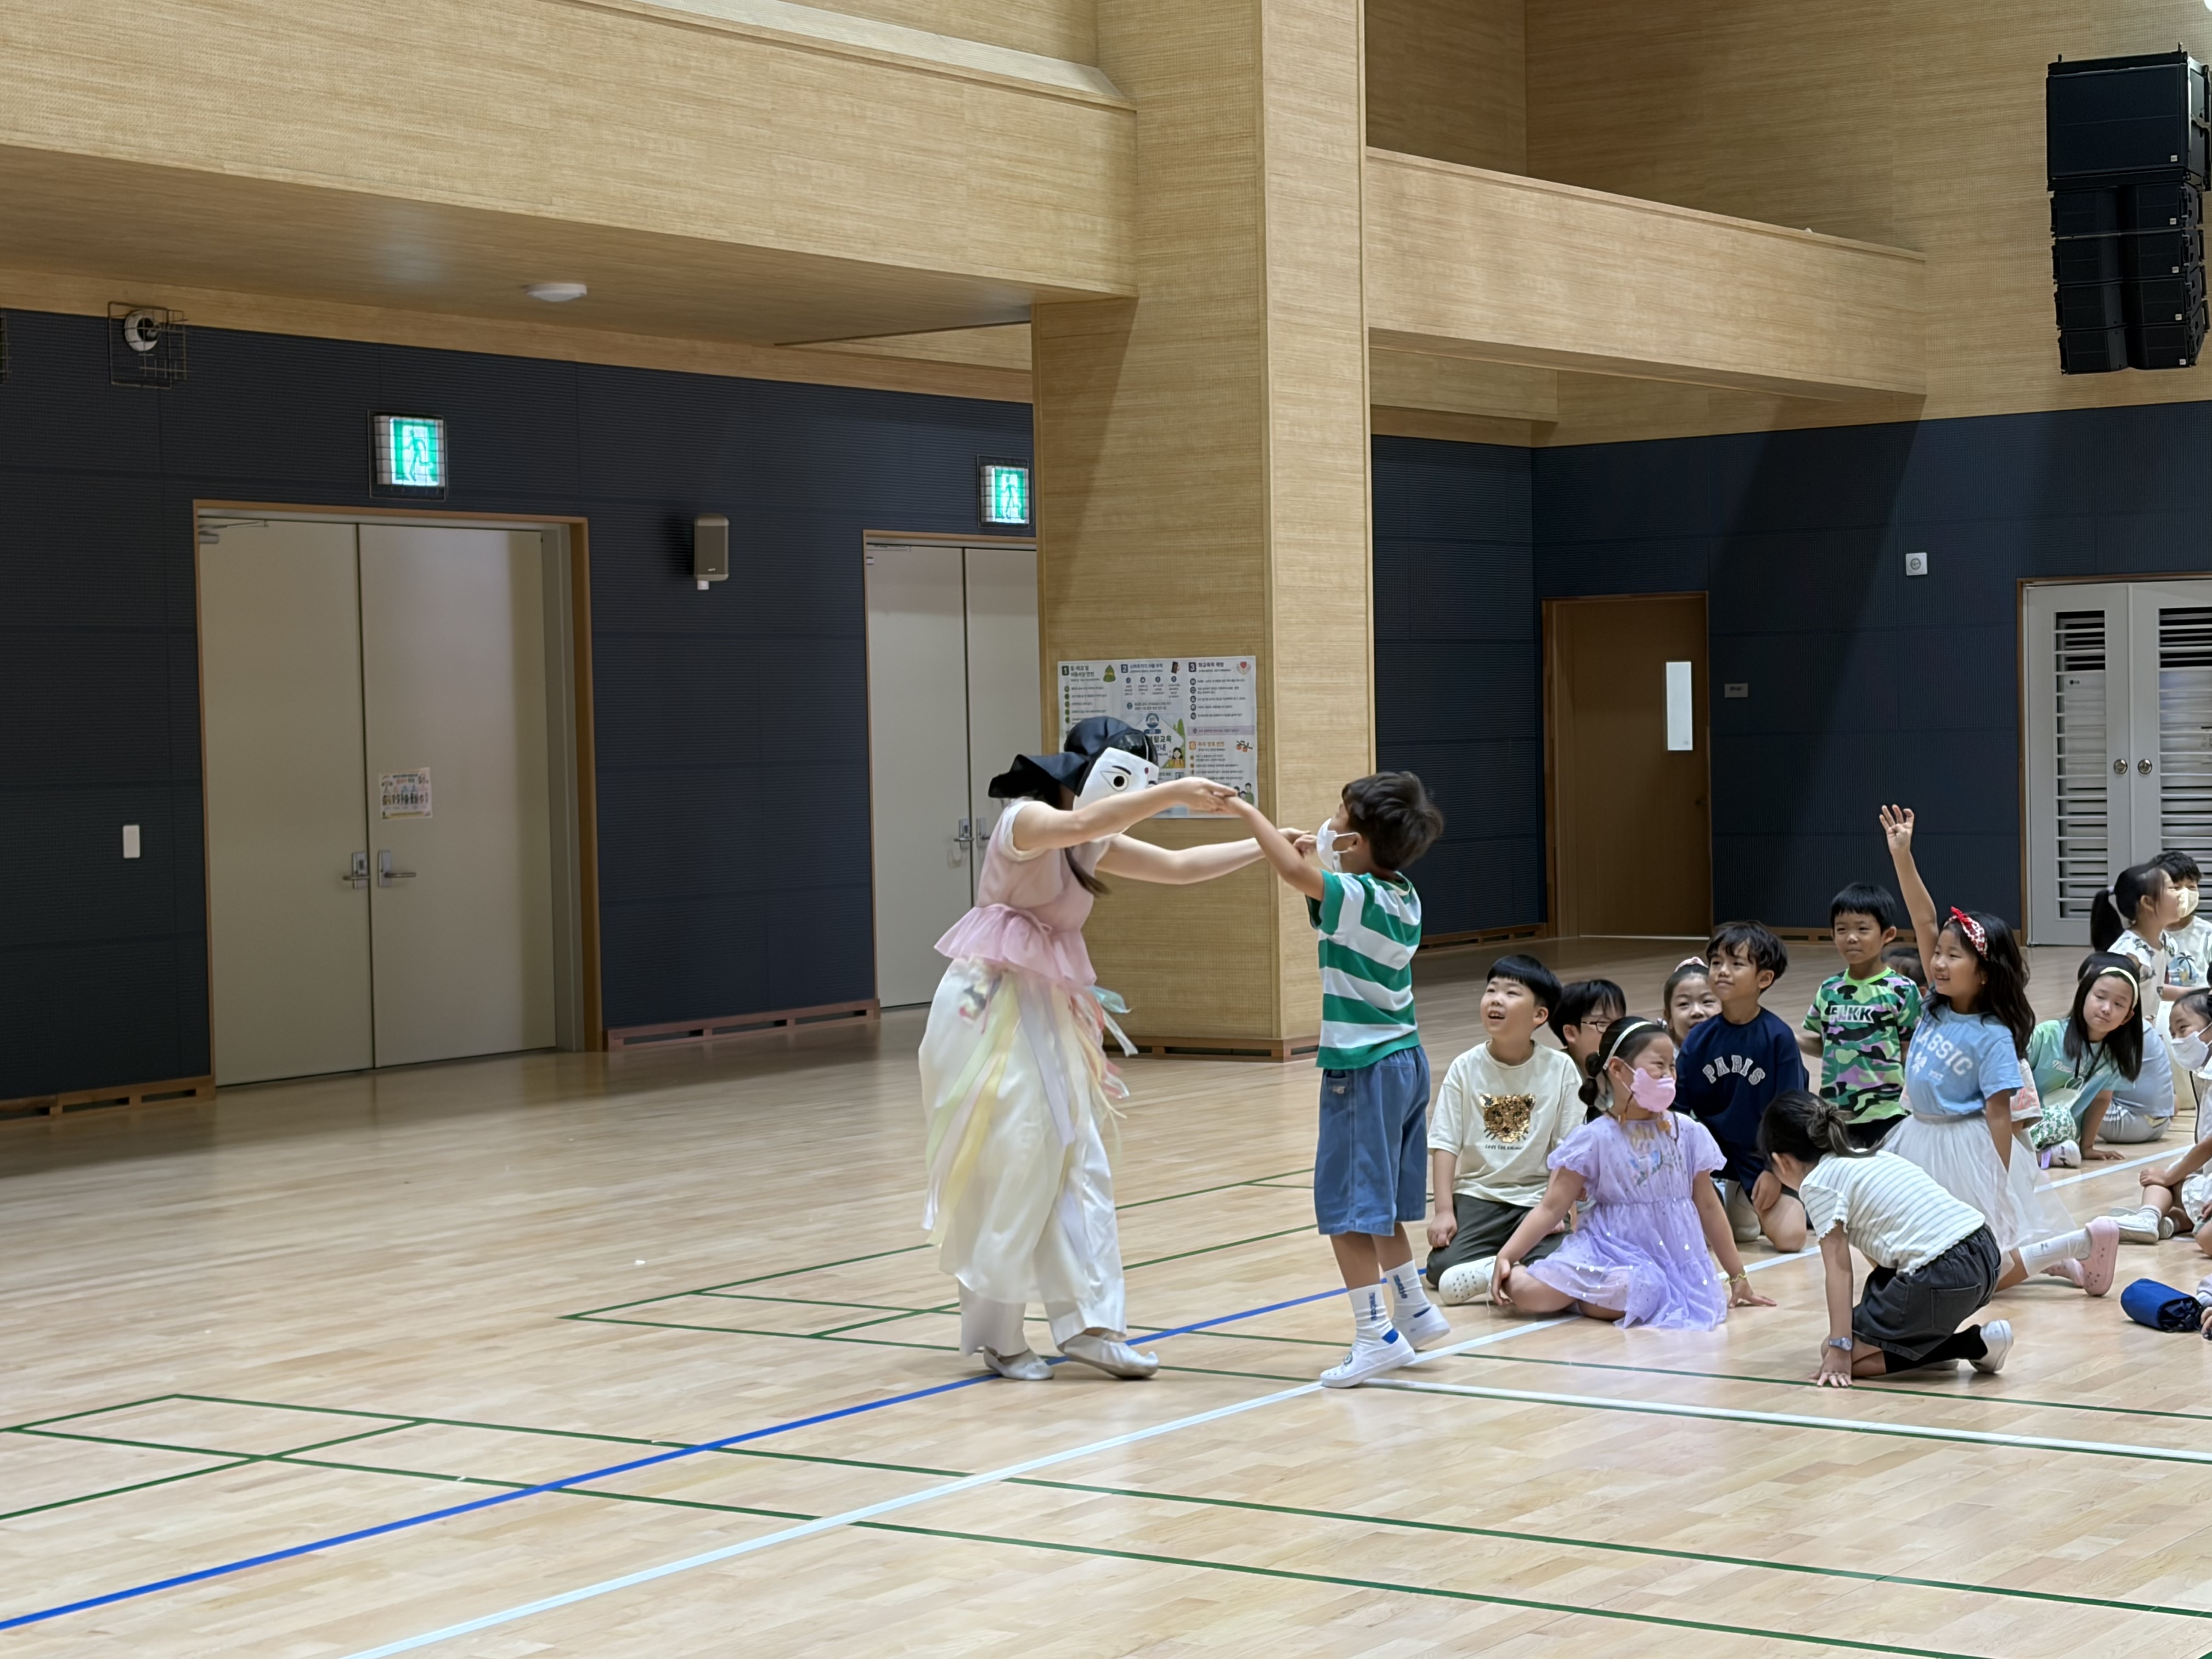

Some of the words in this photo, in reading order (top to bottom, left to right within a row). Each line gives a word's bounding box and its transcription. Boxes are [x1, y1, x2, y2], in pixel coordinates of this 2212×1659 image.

[1063, 667, 1068, 675] 1
[1189, 663, 1195, 672] 3
[1702, 1054, 1765, 1085] PARIS
